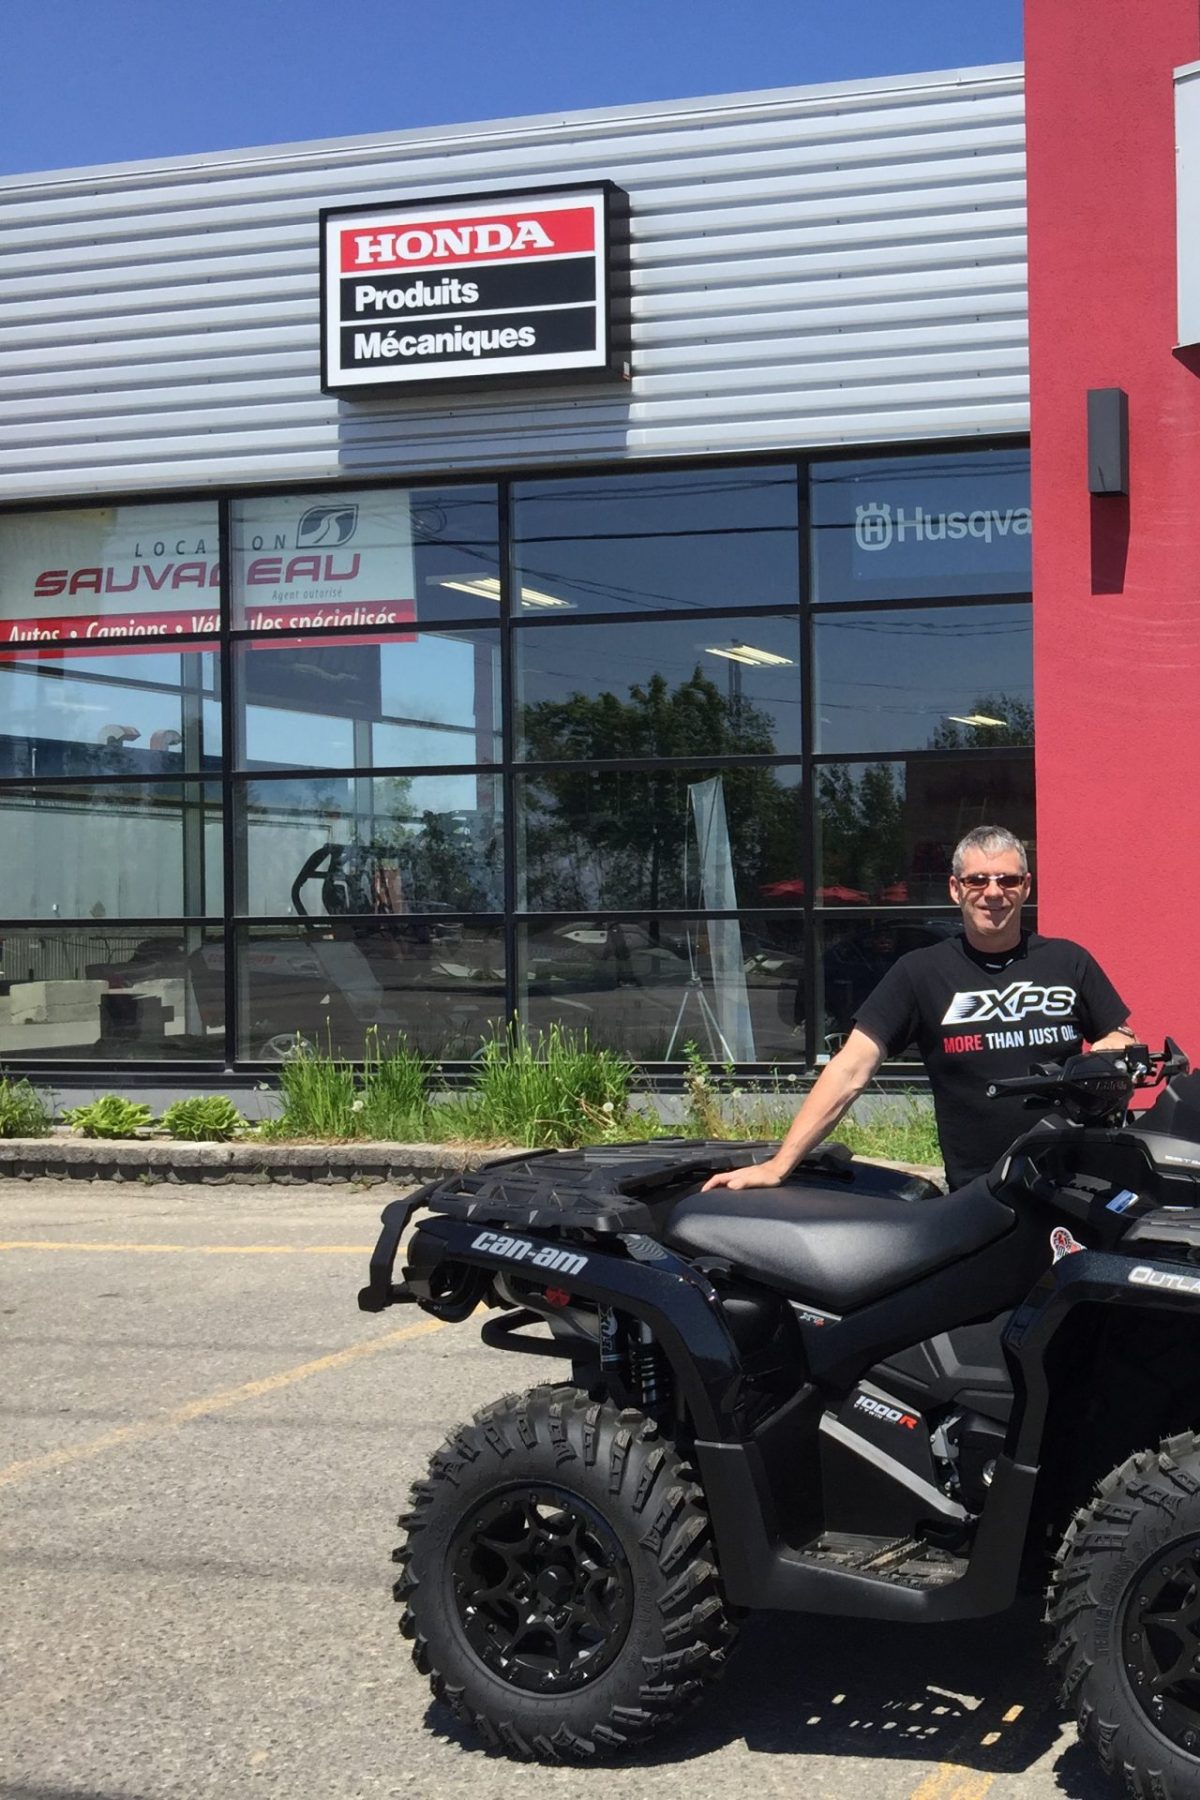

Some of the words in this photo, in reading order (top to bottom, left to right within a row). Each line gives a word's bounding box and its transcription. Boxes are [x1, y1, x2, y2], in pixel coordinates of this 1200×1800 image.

[354, 220, 555, 265] HONDA
[354, 277, 479, 313] Produits
[354, 324, 536, 360] Mécaniques
[134, 534, 287, 558] LOCAON
[34, 553, 361, 598] SAUVAEAU
[8, 625, 61, 643] Autos
[86, 619, 169, 639] Camions
[964, 981, 1077, 1023] XPS
[943, 1034, 984, 1054] MORE
[985, 1030, 1025, 1050] THAN
[1028, 1025, 1059, 1046] JUST
[1061, 1024, 1078, 1042] OIL
[471, 1231, 589, 1275] can-am
[855, 1395, 918, 1430] 1000R
